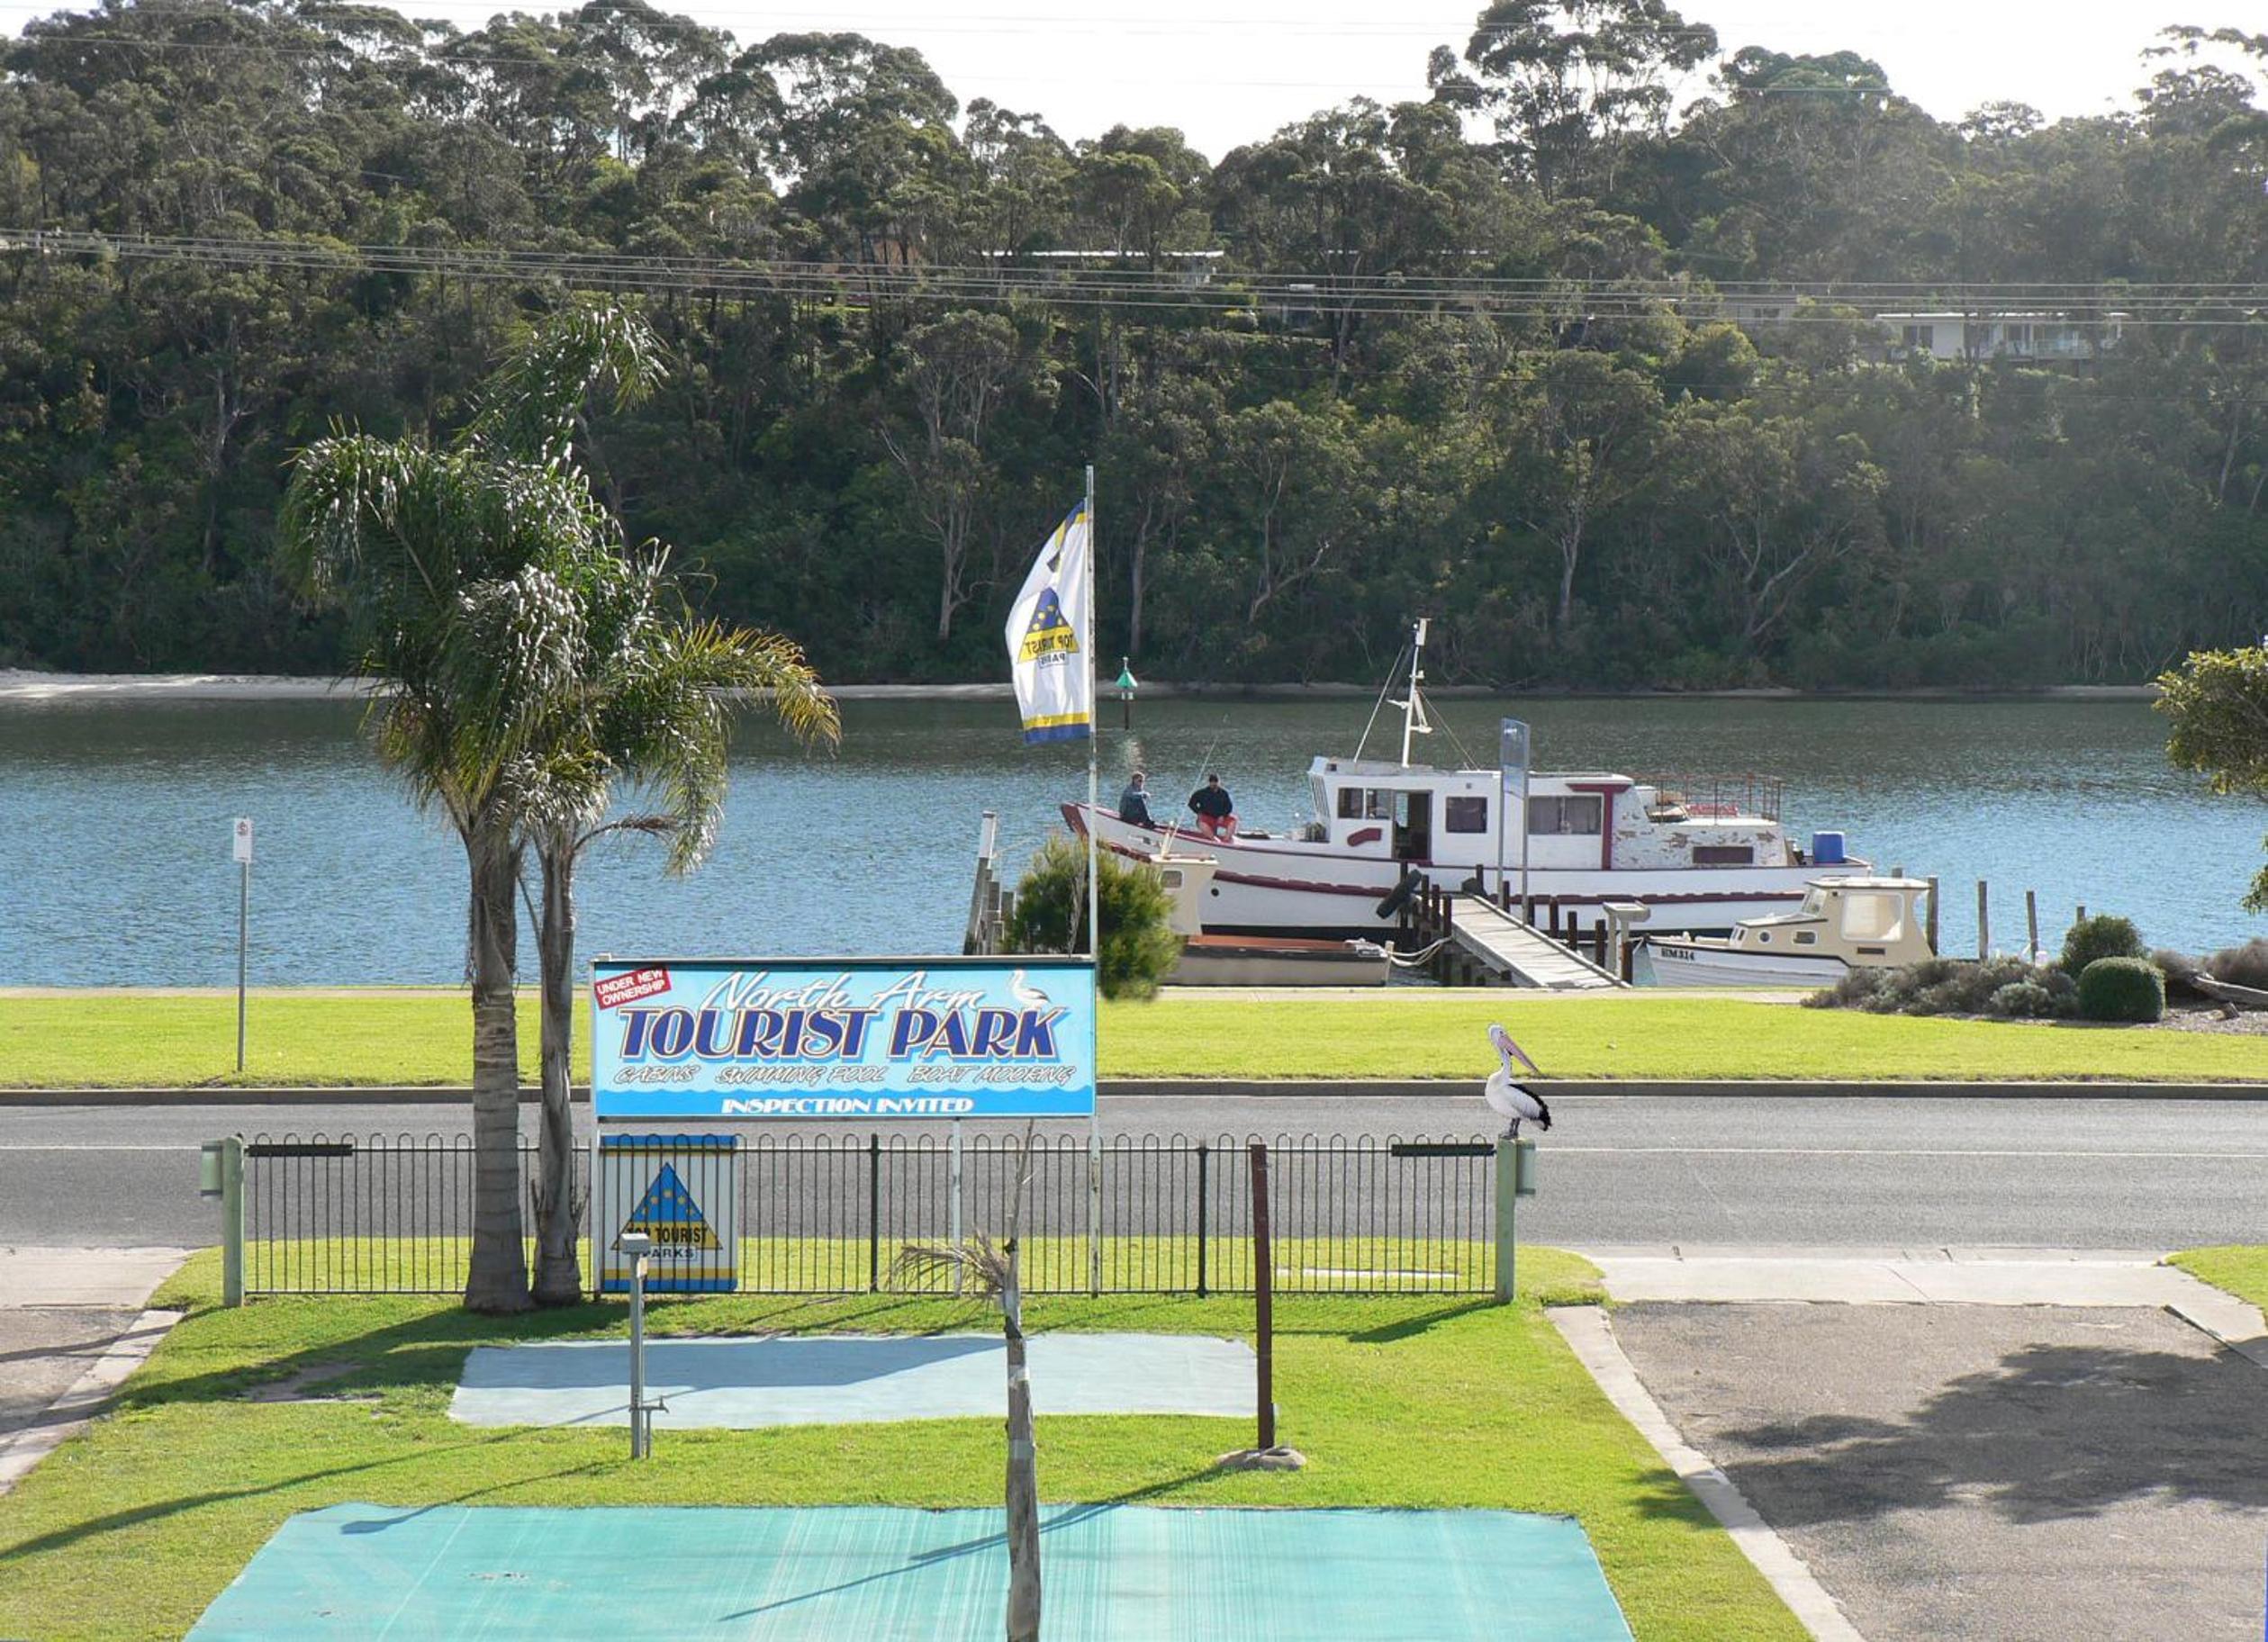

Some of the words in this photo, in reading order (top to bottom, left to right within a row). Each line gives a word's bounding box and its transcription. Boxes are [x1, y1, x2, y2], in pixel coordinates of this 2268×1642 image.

[596, 976, 635, 994] UNDER
[637, 970, 664, 984] NEW
[601, 979, 664, 1006] OWNERSHIP
[699, 971, 853, 1010] North
[868, 970, 985, 1010] Arm
[619, 1007, 882, 1060] TOURIST
[886, 1007, 1067, 1060] PARK
[613, 1065, 701, 1085] CABINS
[715, 1065, 827, 1087] SWIMMING
[826, 1065, 889, 1084] POOL
[907, 1065, 974, 1084] BOAT
[971, 1065, 1077, 1086] MOORING
[720, 1098, 872, 1114] INSPECTION
[875, 1097, 975, 1114] INVITED
[655, 1227, 709, 1243] TOURIST
